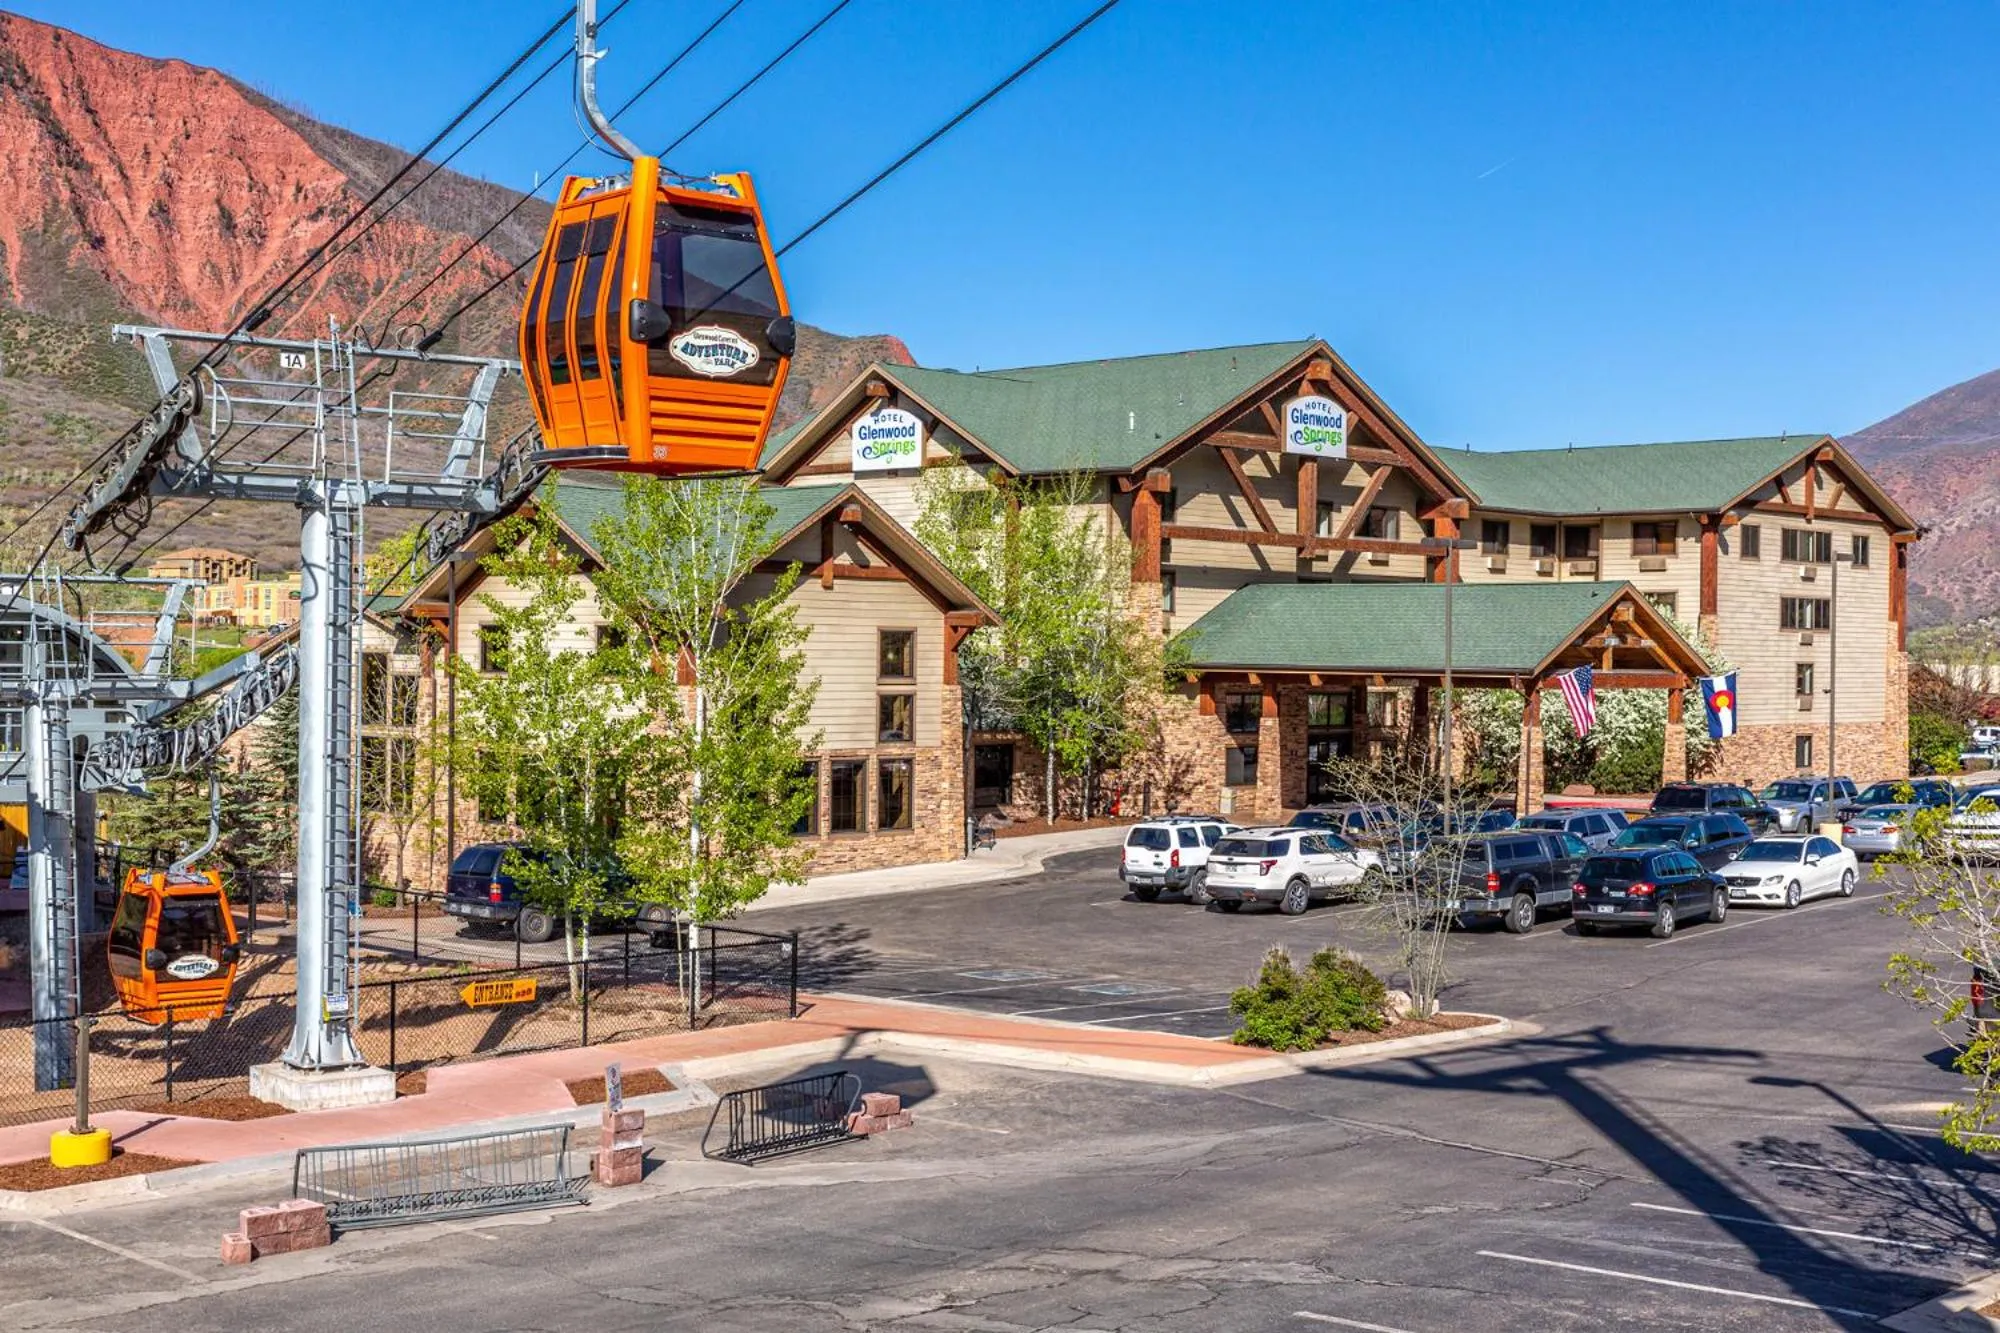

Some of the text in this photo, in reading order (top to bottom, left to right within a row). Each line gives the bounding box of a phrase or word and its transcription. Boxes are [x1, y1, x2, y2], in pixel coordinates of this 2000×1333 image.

[285, 355, 301, 368] 1A
[681, 342, 748, 364] ADVENTURE
[714, 359, 736, 369] PARK
[1305, 401, 1331, 414] HOTEL
[874, 414, 903, 424] HOTEL
[1291, 408, 1342, 428] Glenwood
[859, 422, 915, 440] Glenwood
[1303, 426, 1342, 446] Springs
[872, 440, 915, 456] Springs
[474, 983, 513, 1003] ENTRANCE
